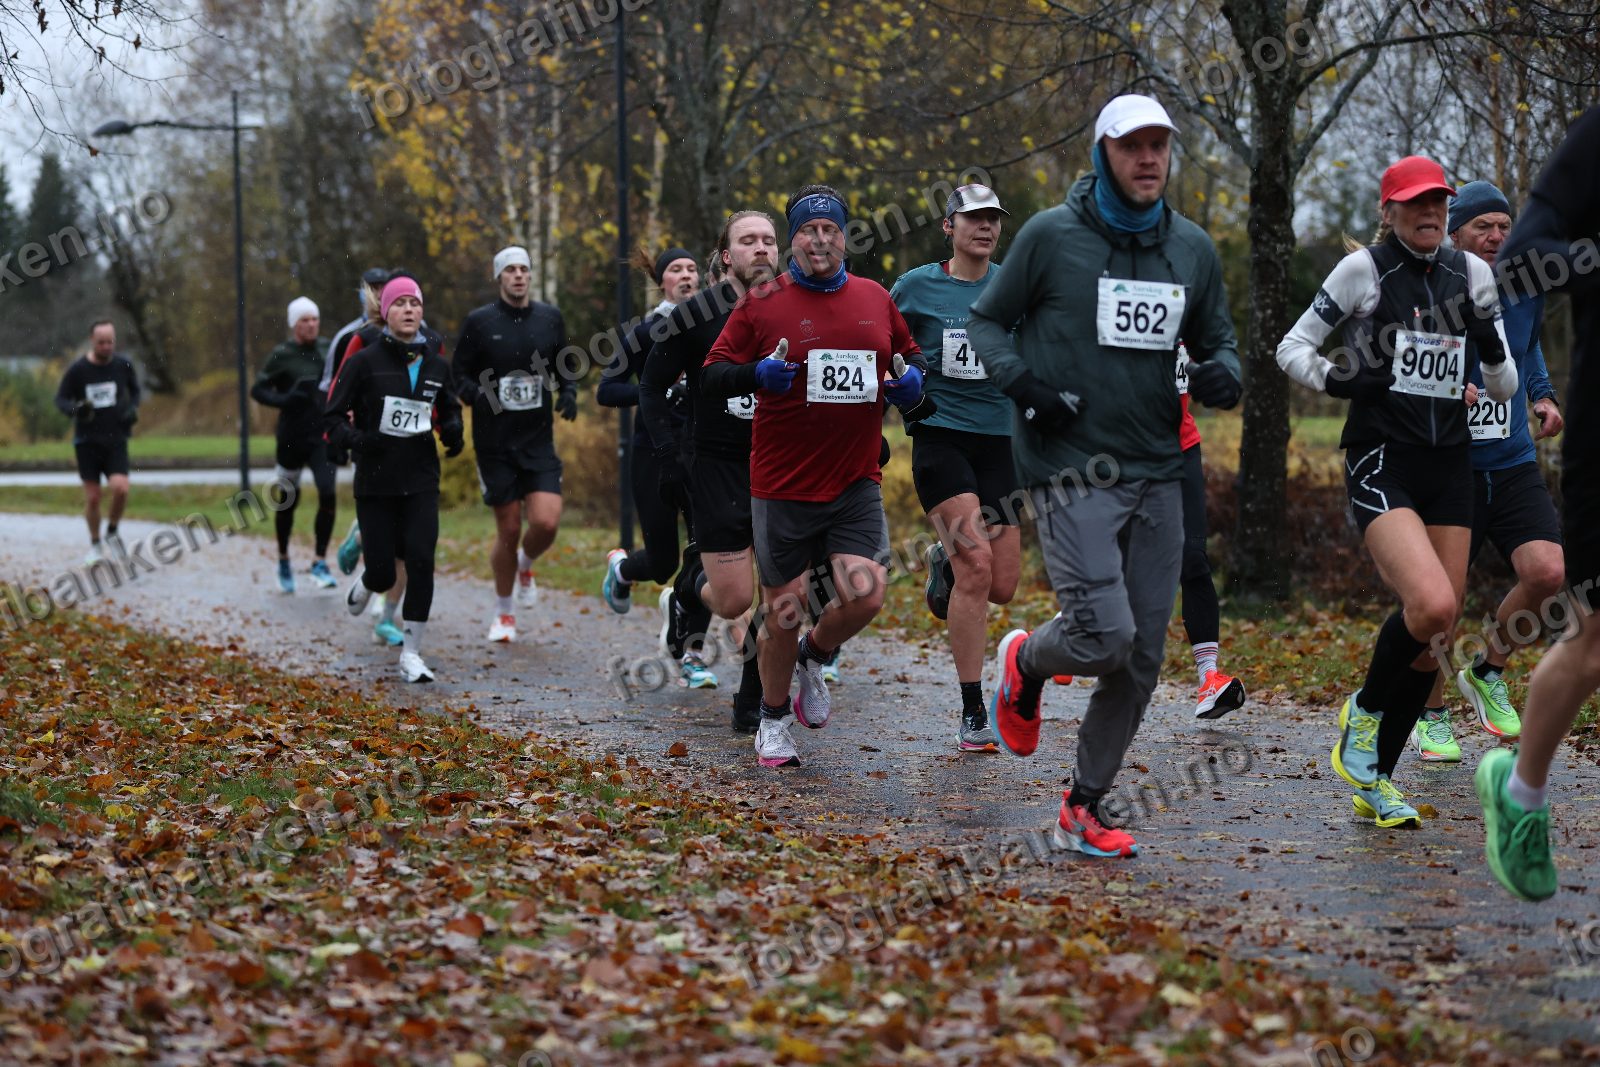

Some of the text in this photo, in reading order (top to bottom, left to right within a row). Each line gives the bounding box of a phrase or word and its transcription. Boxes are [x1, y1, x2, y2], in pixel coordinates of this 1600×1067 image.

[1115, 300, 1168, 336] 562
[822, 365, 865, 392] 824
[1400, 347, 1459, 383] 9004
[391, 410, 421, 431] 671
